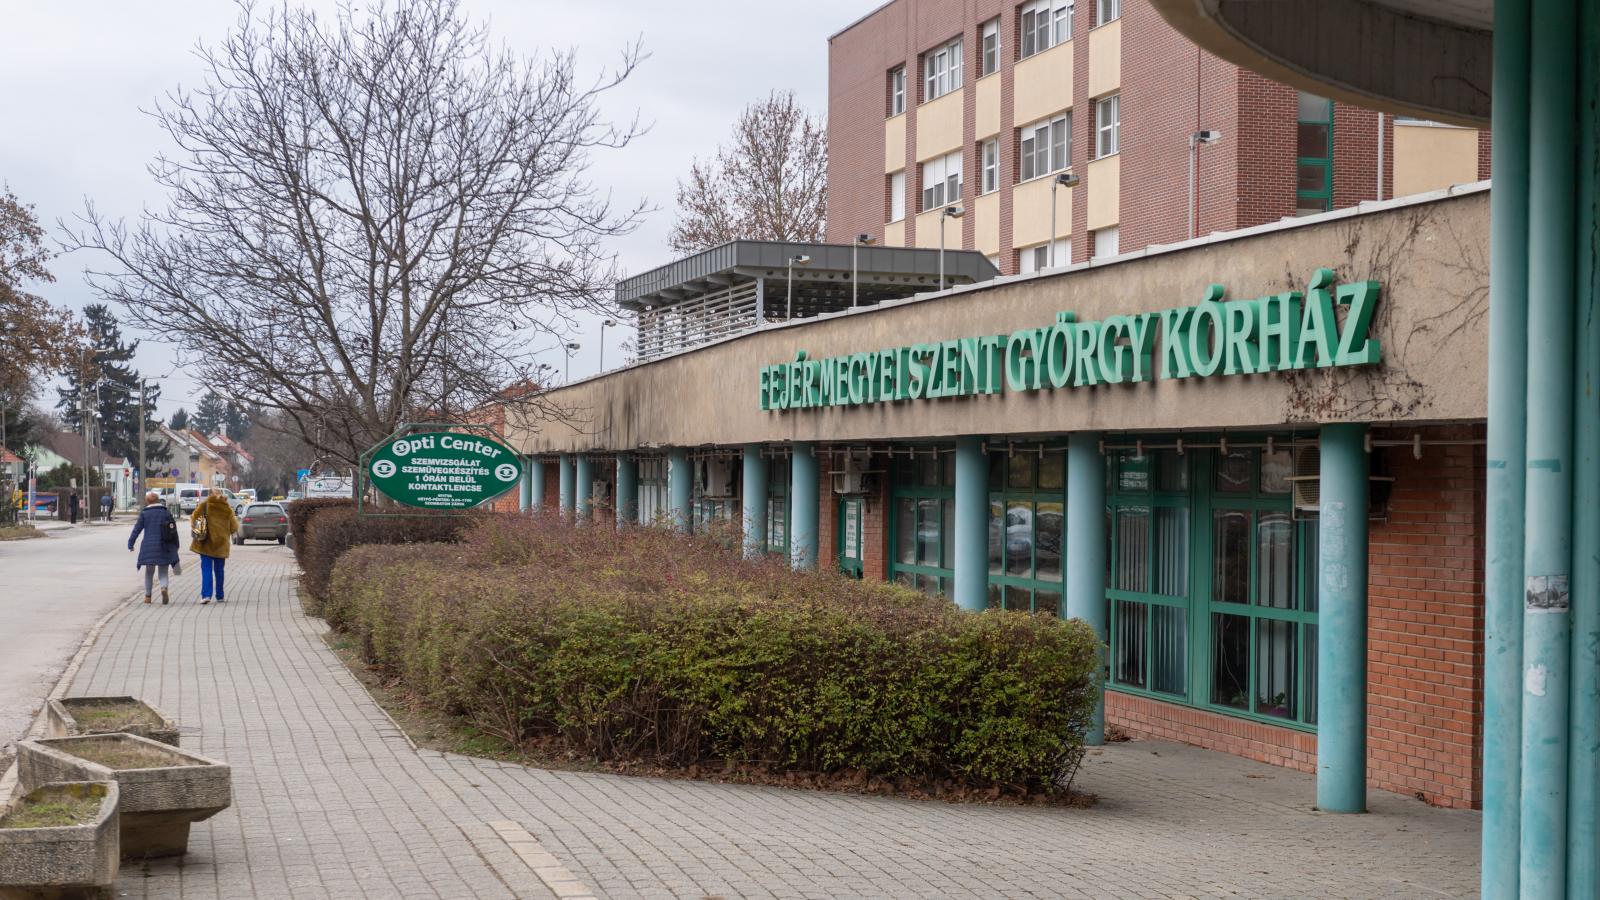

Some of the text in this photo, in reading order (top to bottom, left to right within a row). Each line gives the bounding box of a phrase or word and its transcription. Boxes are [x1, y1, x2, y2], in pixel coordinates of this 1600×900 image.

[759, 267, 1381, 410] FEJÉR MEGYEI SZENT GYÖRGY KÓRHÁZ
[392, 436, 501, 458] Opti Center
[411, 458, 480, 466] SZEMVIZSGÁLAT
[422, 474, 447, 482] ÓRÁN
[449, 475, 476, 483] BELÜL
[408, 483, 482, 492] KONTAKTLENCSE
